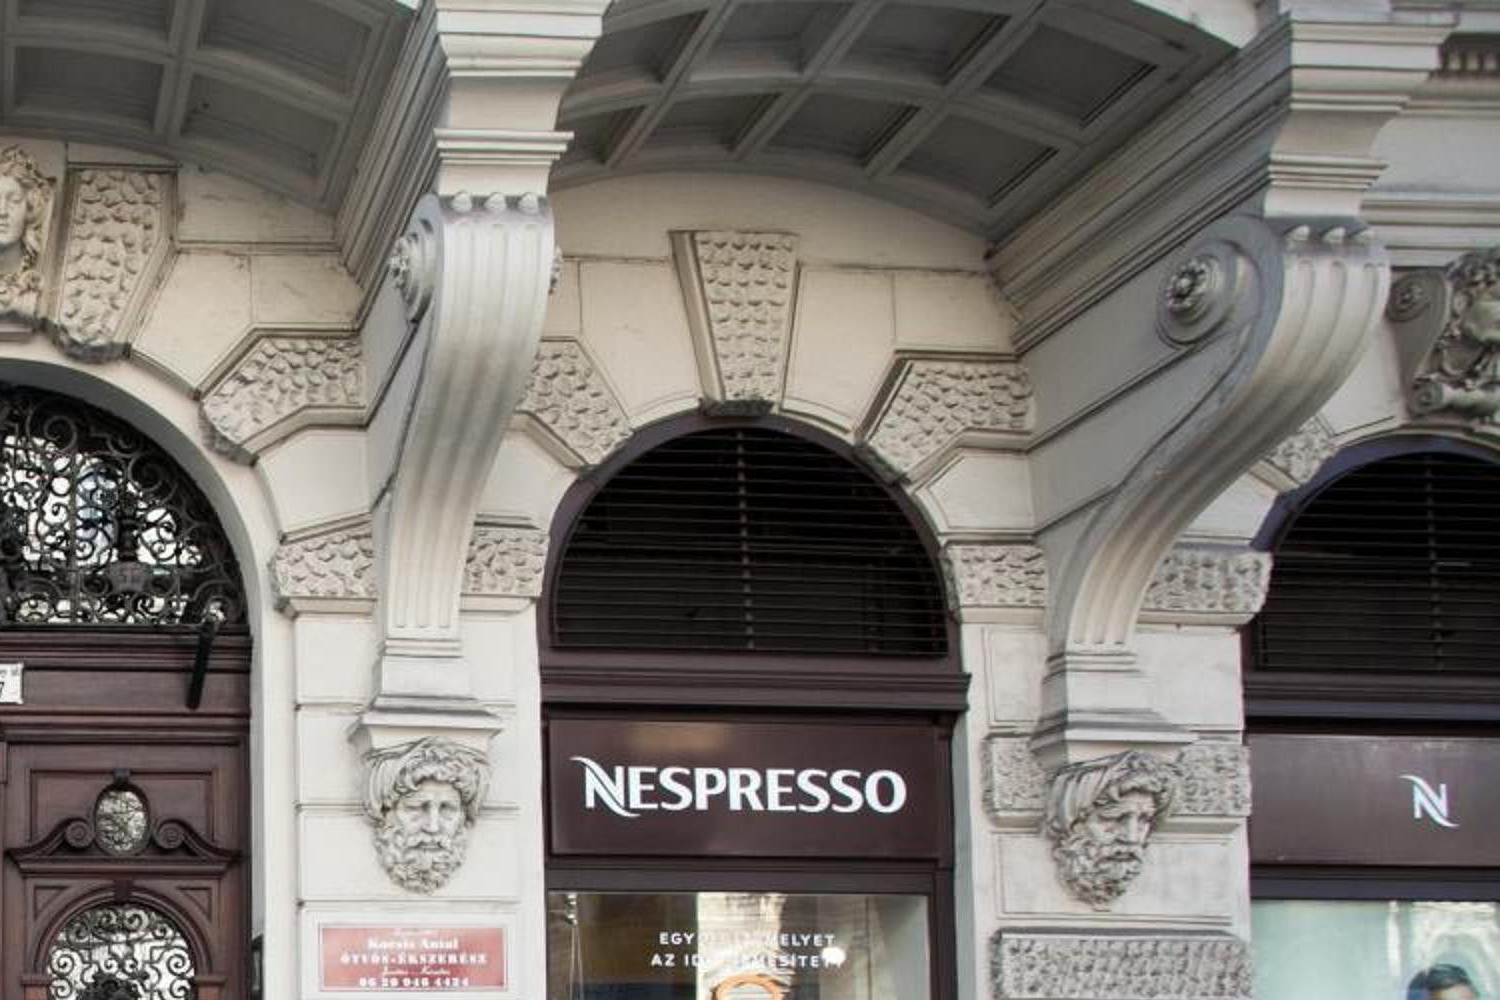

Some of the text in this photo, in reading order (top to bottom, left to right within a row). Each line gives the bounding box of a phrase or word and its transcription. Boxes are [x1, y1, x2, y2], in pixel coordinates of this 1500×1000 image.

[570, 757, 907, 817] NESPRESSO
[1399, 775, 1460, 827] N
[659, 932, 695, 946] EGY
[651, 953, 676, 967] AZ
